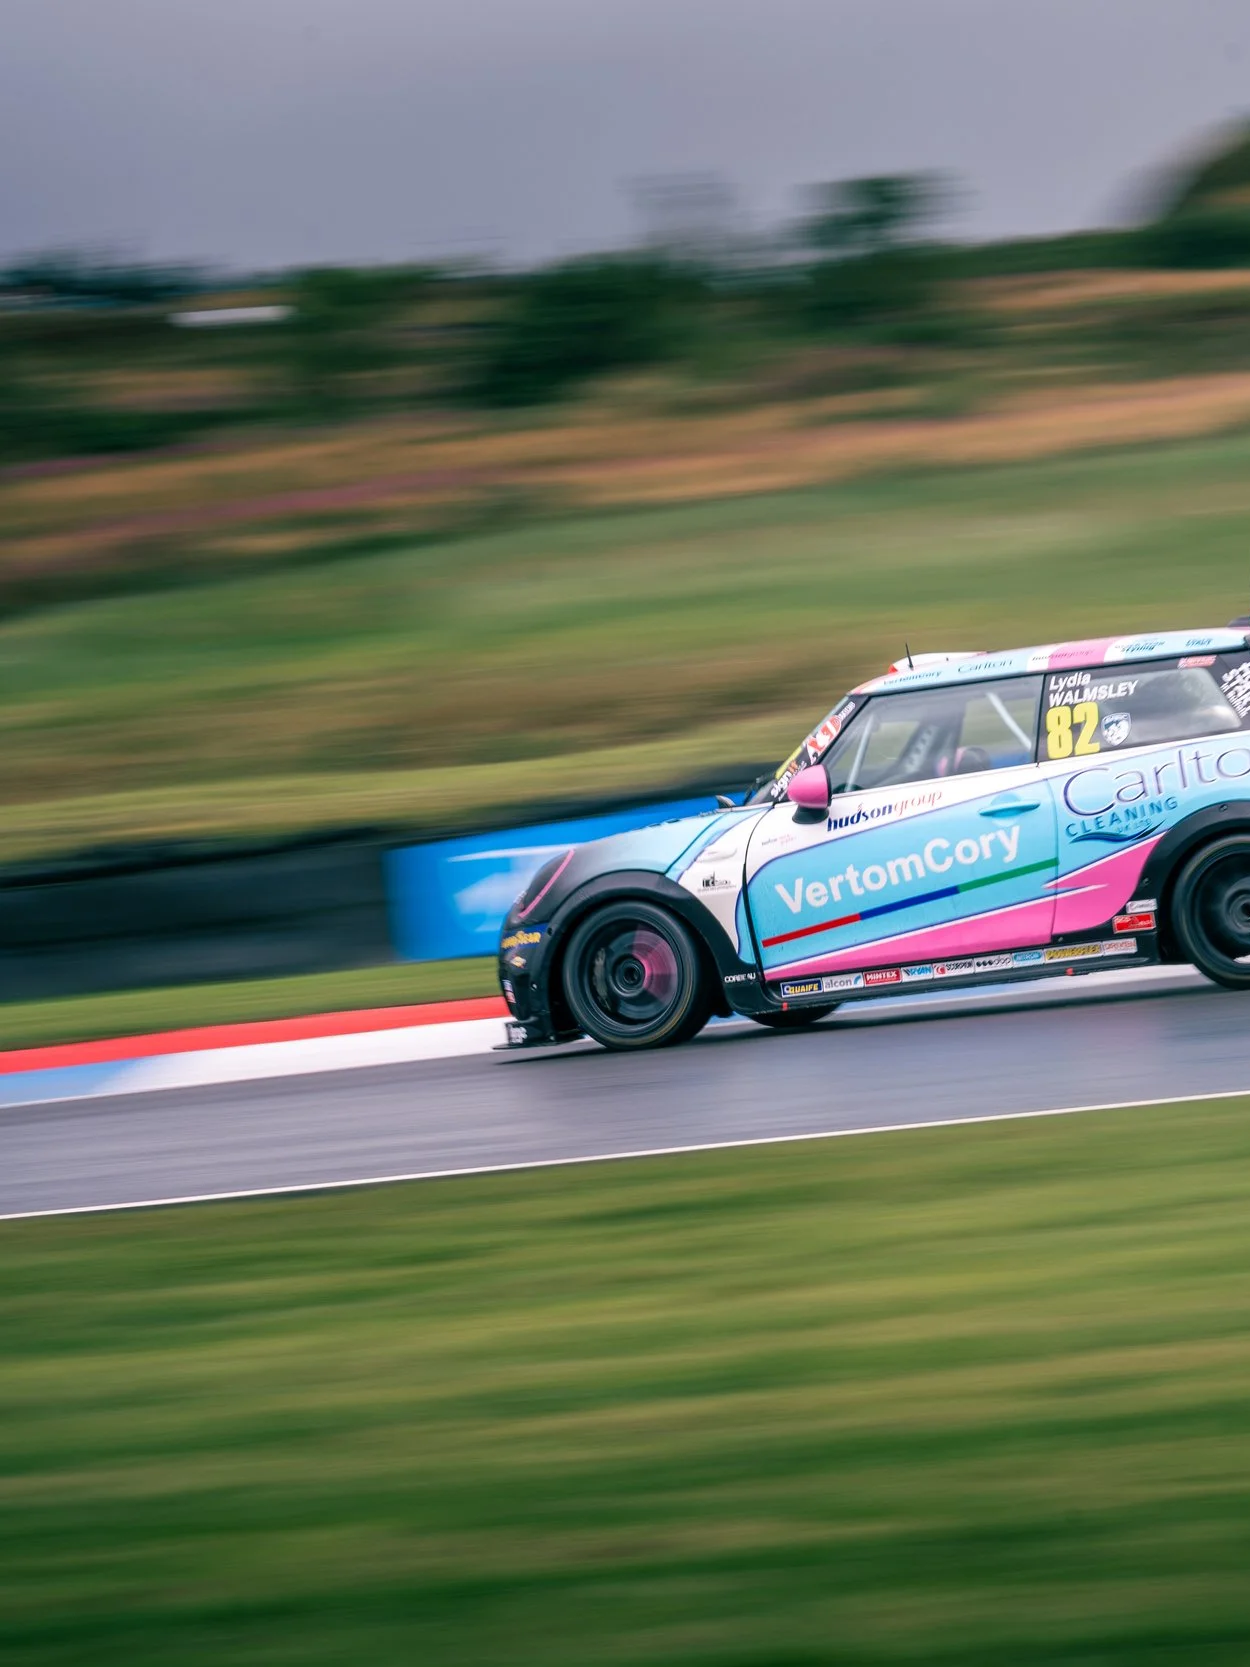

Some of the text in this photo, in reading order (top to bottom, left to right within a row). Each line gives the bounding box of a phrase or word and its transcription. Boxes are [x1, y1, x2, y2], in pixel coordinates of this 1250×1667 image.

[1049, 672, 1091, 692] Lydia
[1049, 680, 1139, 708] WALMSLEY
[1046, 701, 1100, 760] 82
[1065, 796, 1179, 838] CLEANING
[774, 826, 1020, 914] VertomCory
[825, 978, 853, 989] alcon
[866, 970, 898, 981] MINTEX
